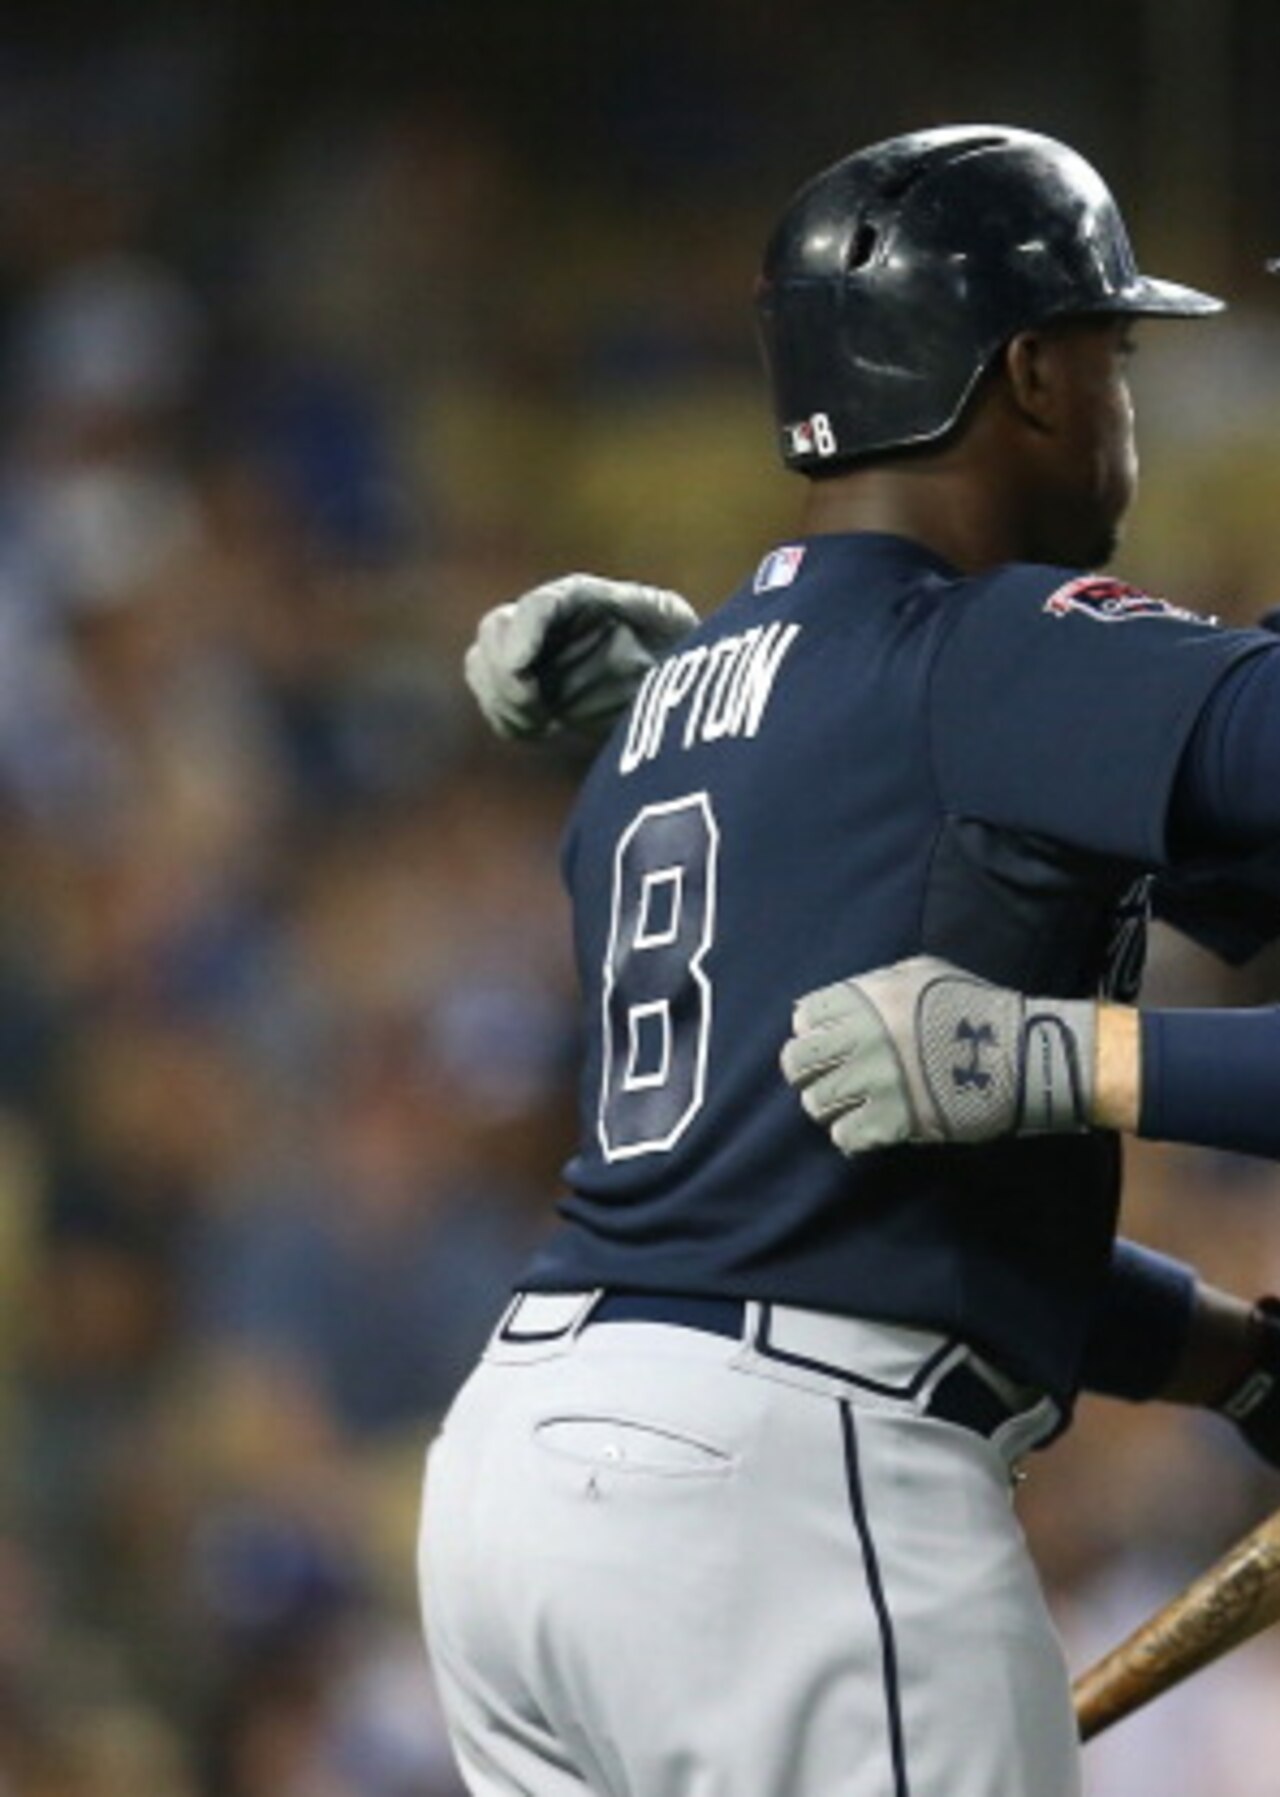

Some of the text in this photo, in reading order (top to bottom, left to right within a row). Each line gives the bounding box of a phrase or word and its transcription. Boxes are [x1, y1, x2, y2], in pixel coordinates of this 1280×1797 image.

[810, 412, 837, 457] 8
[618, 620, 801, 775] UPTON
[598, 791, 720, 1163] 8
